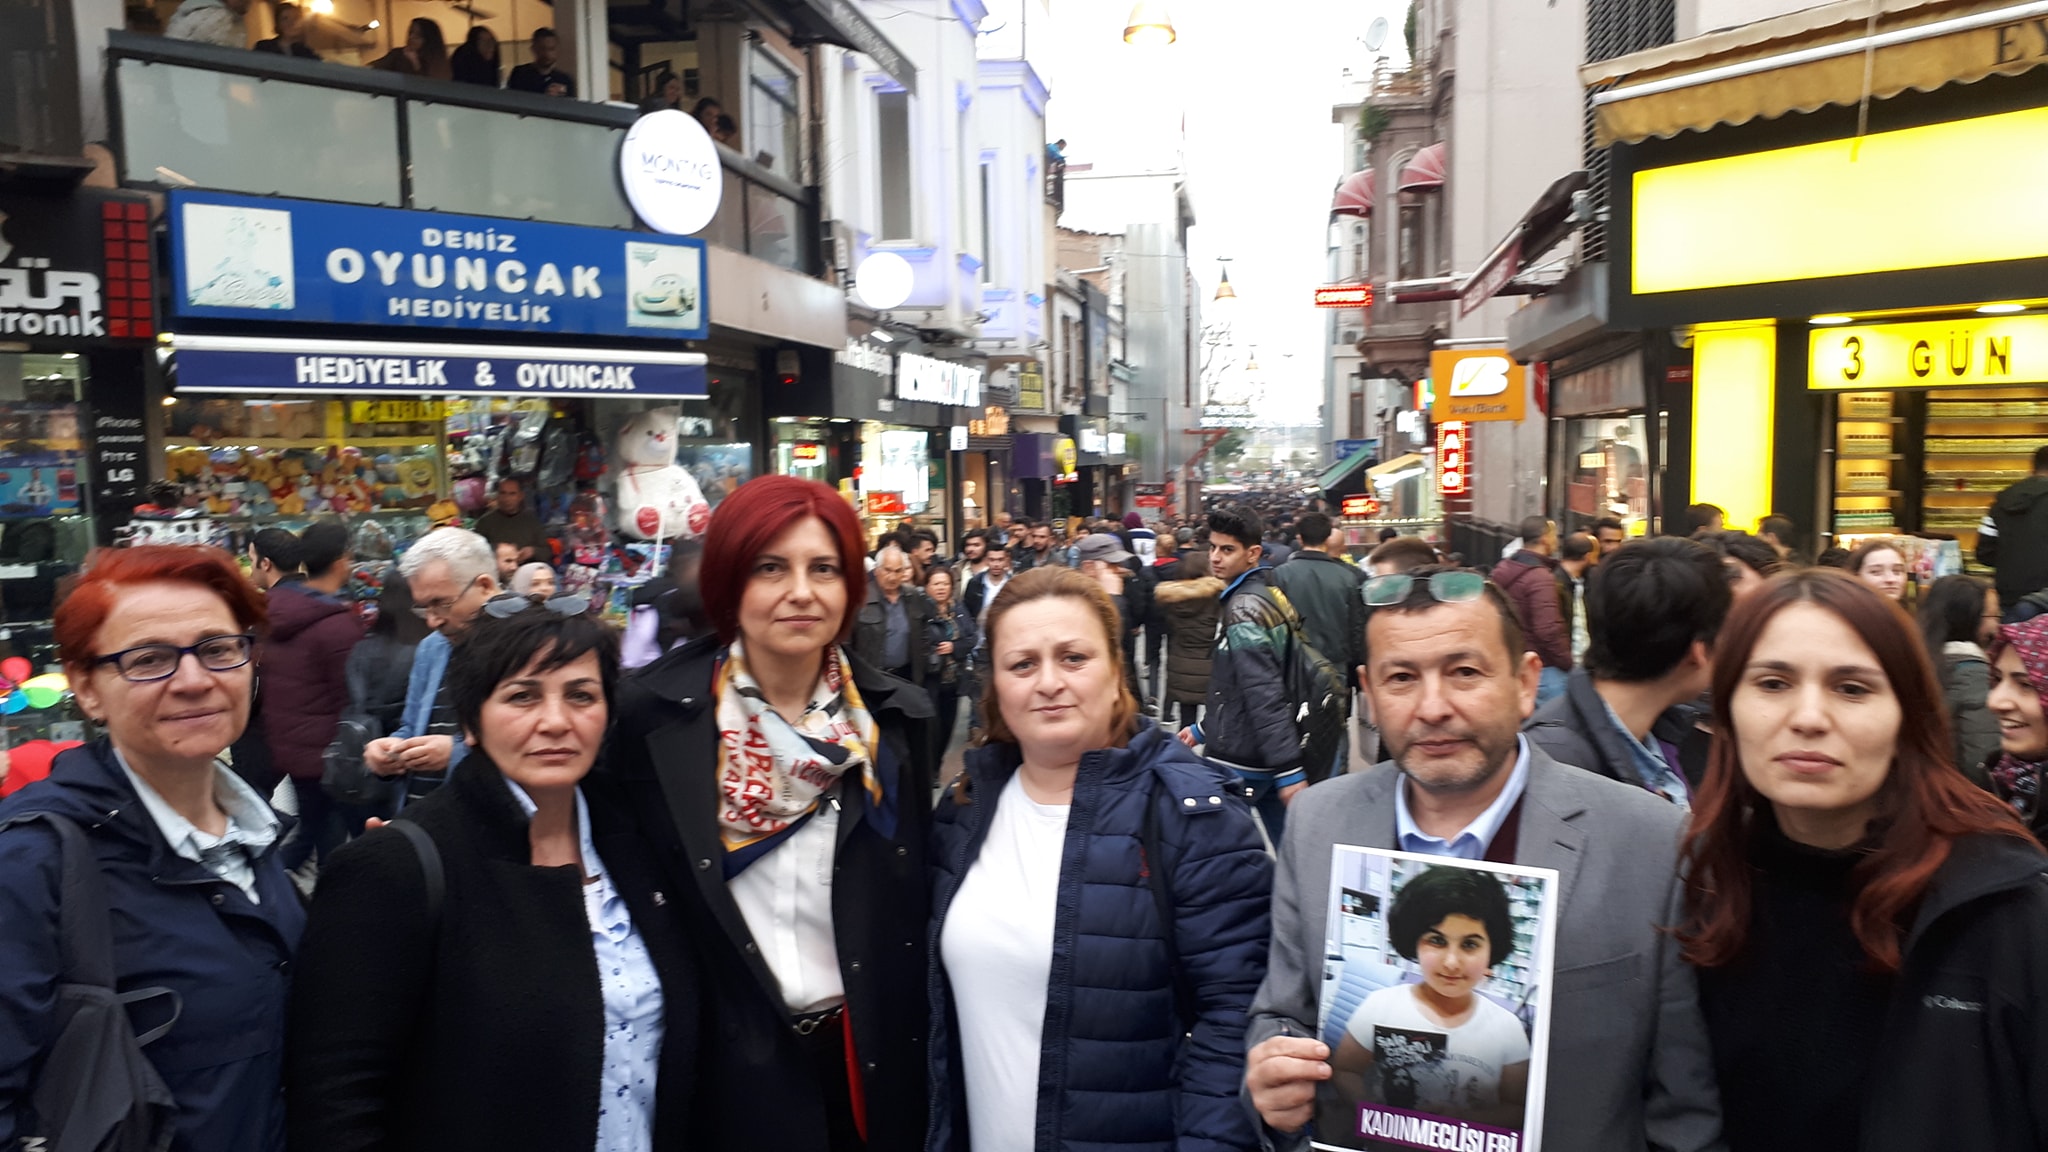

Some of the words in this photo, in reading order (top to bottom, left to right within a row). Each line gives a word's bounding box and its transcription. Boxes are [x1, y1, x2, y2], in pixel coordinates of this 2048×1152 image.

[326, 247, 602, 299] OYUNCAK
[1844, 336, 1861, 380] 3
[1912, 330, 2009, 378] GÜN
[474, 361, 496, 387] &
[516, 363, 635, 389] OYUNCAK
[107, 468, 135, 482] LG
